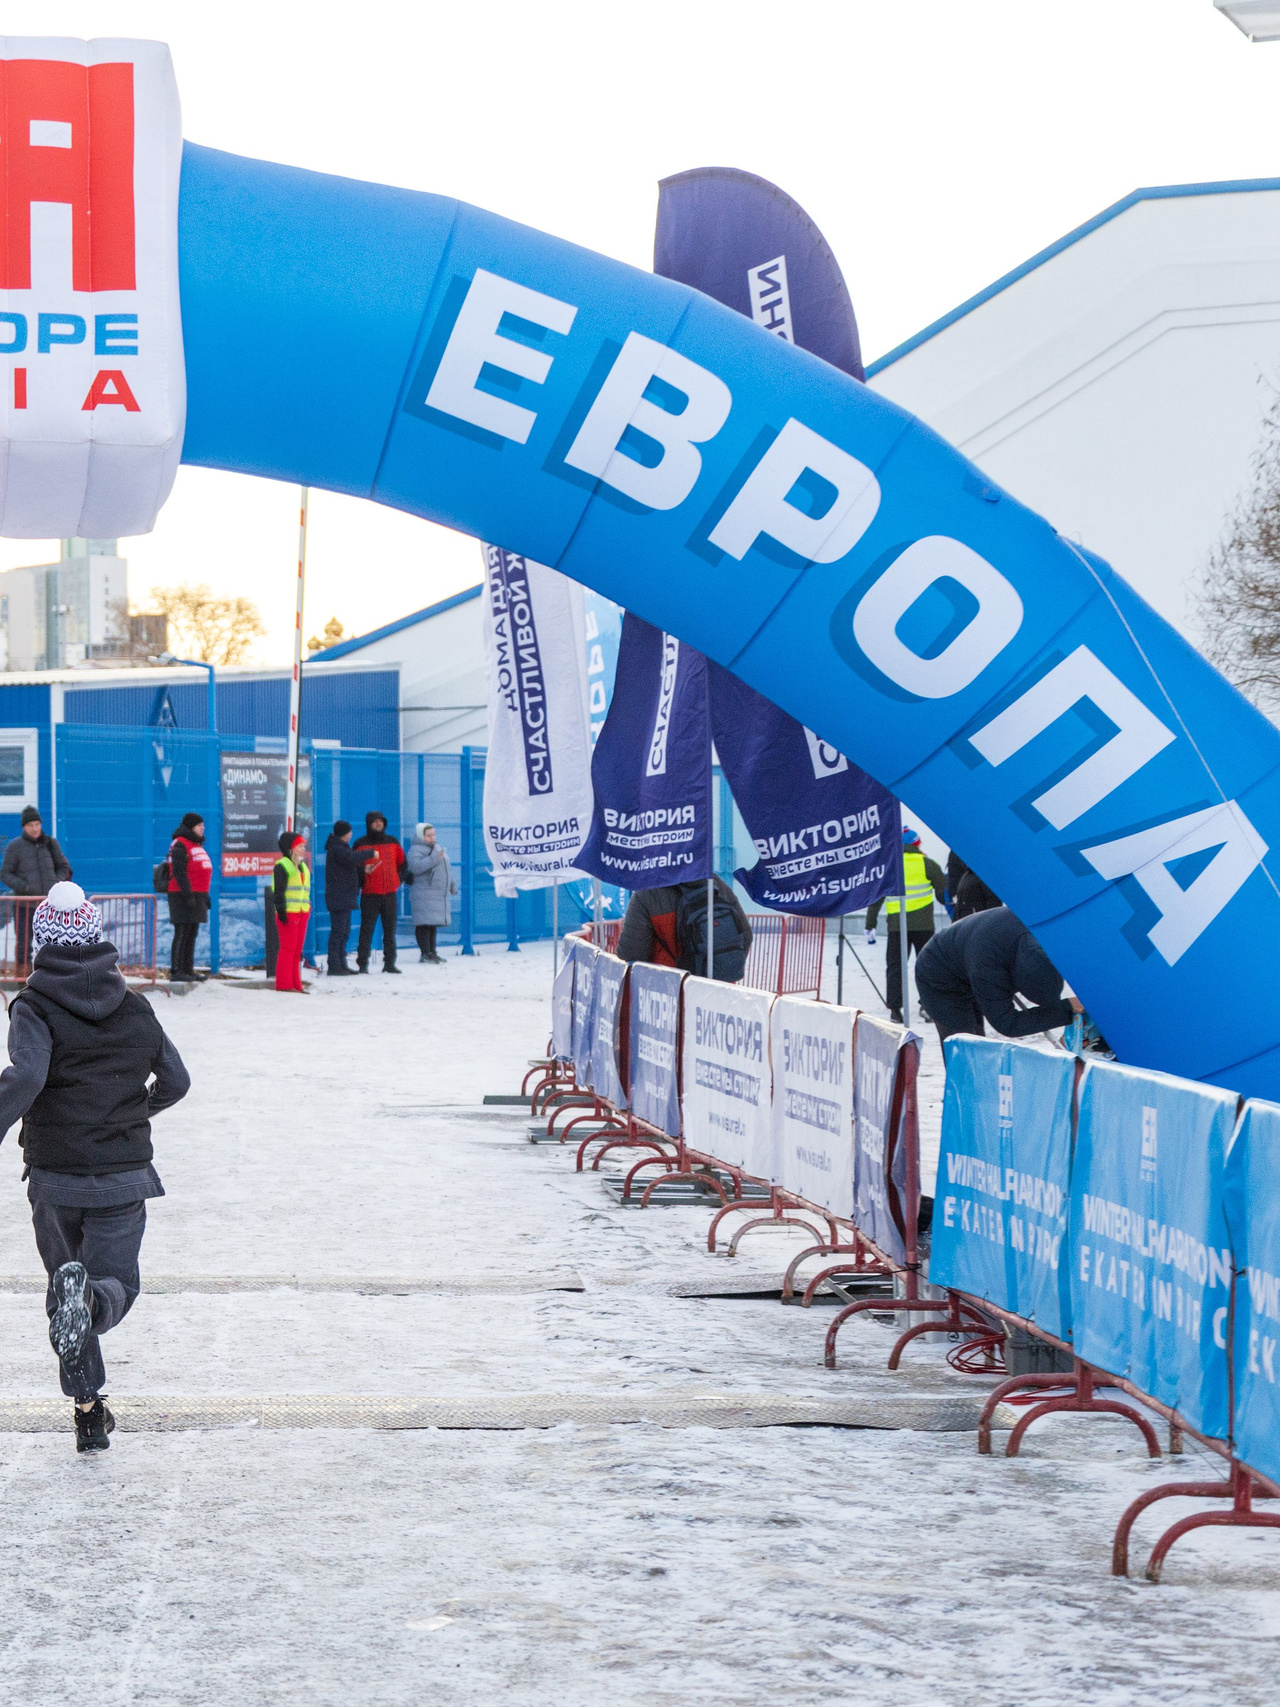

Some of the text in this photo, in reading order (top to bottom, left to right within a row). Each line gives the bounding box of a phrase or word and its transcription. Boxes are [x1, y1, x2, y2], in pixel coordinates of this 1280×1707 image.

[425, 268, 1268, 967] ЕВРОПА
[494, 617, 518, 711] ДОМА
[507, 579, 551, 791] СЧАСТЛИВОЙ
[489, 818, 580, 841] ВИКТОРИЯ
[604, 805, 696, 832] ВИКТОРИЯ
[651, 829, 694, 845] строим
[755, 805, 880, 860] ВИКТОРИЯ
[543, 837, 580, 850] строим
[600, 852, 694, 872] www.visural.ru
[768, 836, 881, 877] вместе мы строим
[223, 857, 259, 873] 290-46-61
[763, 864, 886, 903] www.visural.ru
[696, 1006, 763, 1063] ВИКТОРИЯ
[783, 1028, 846, 1086] ВИКТОРИЯ
[1083, 1194, 1130, 1246] WINTER
